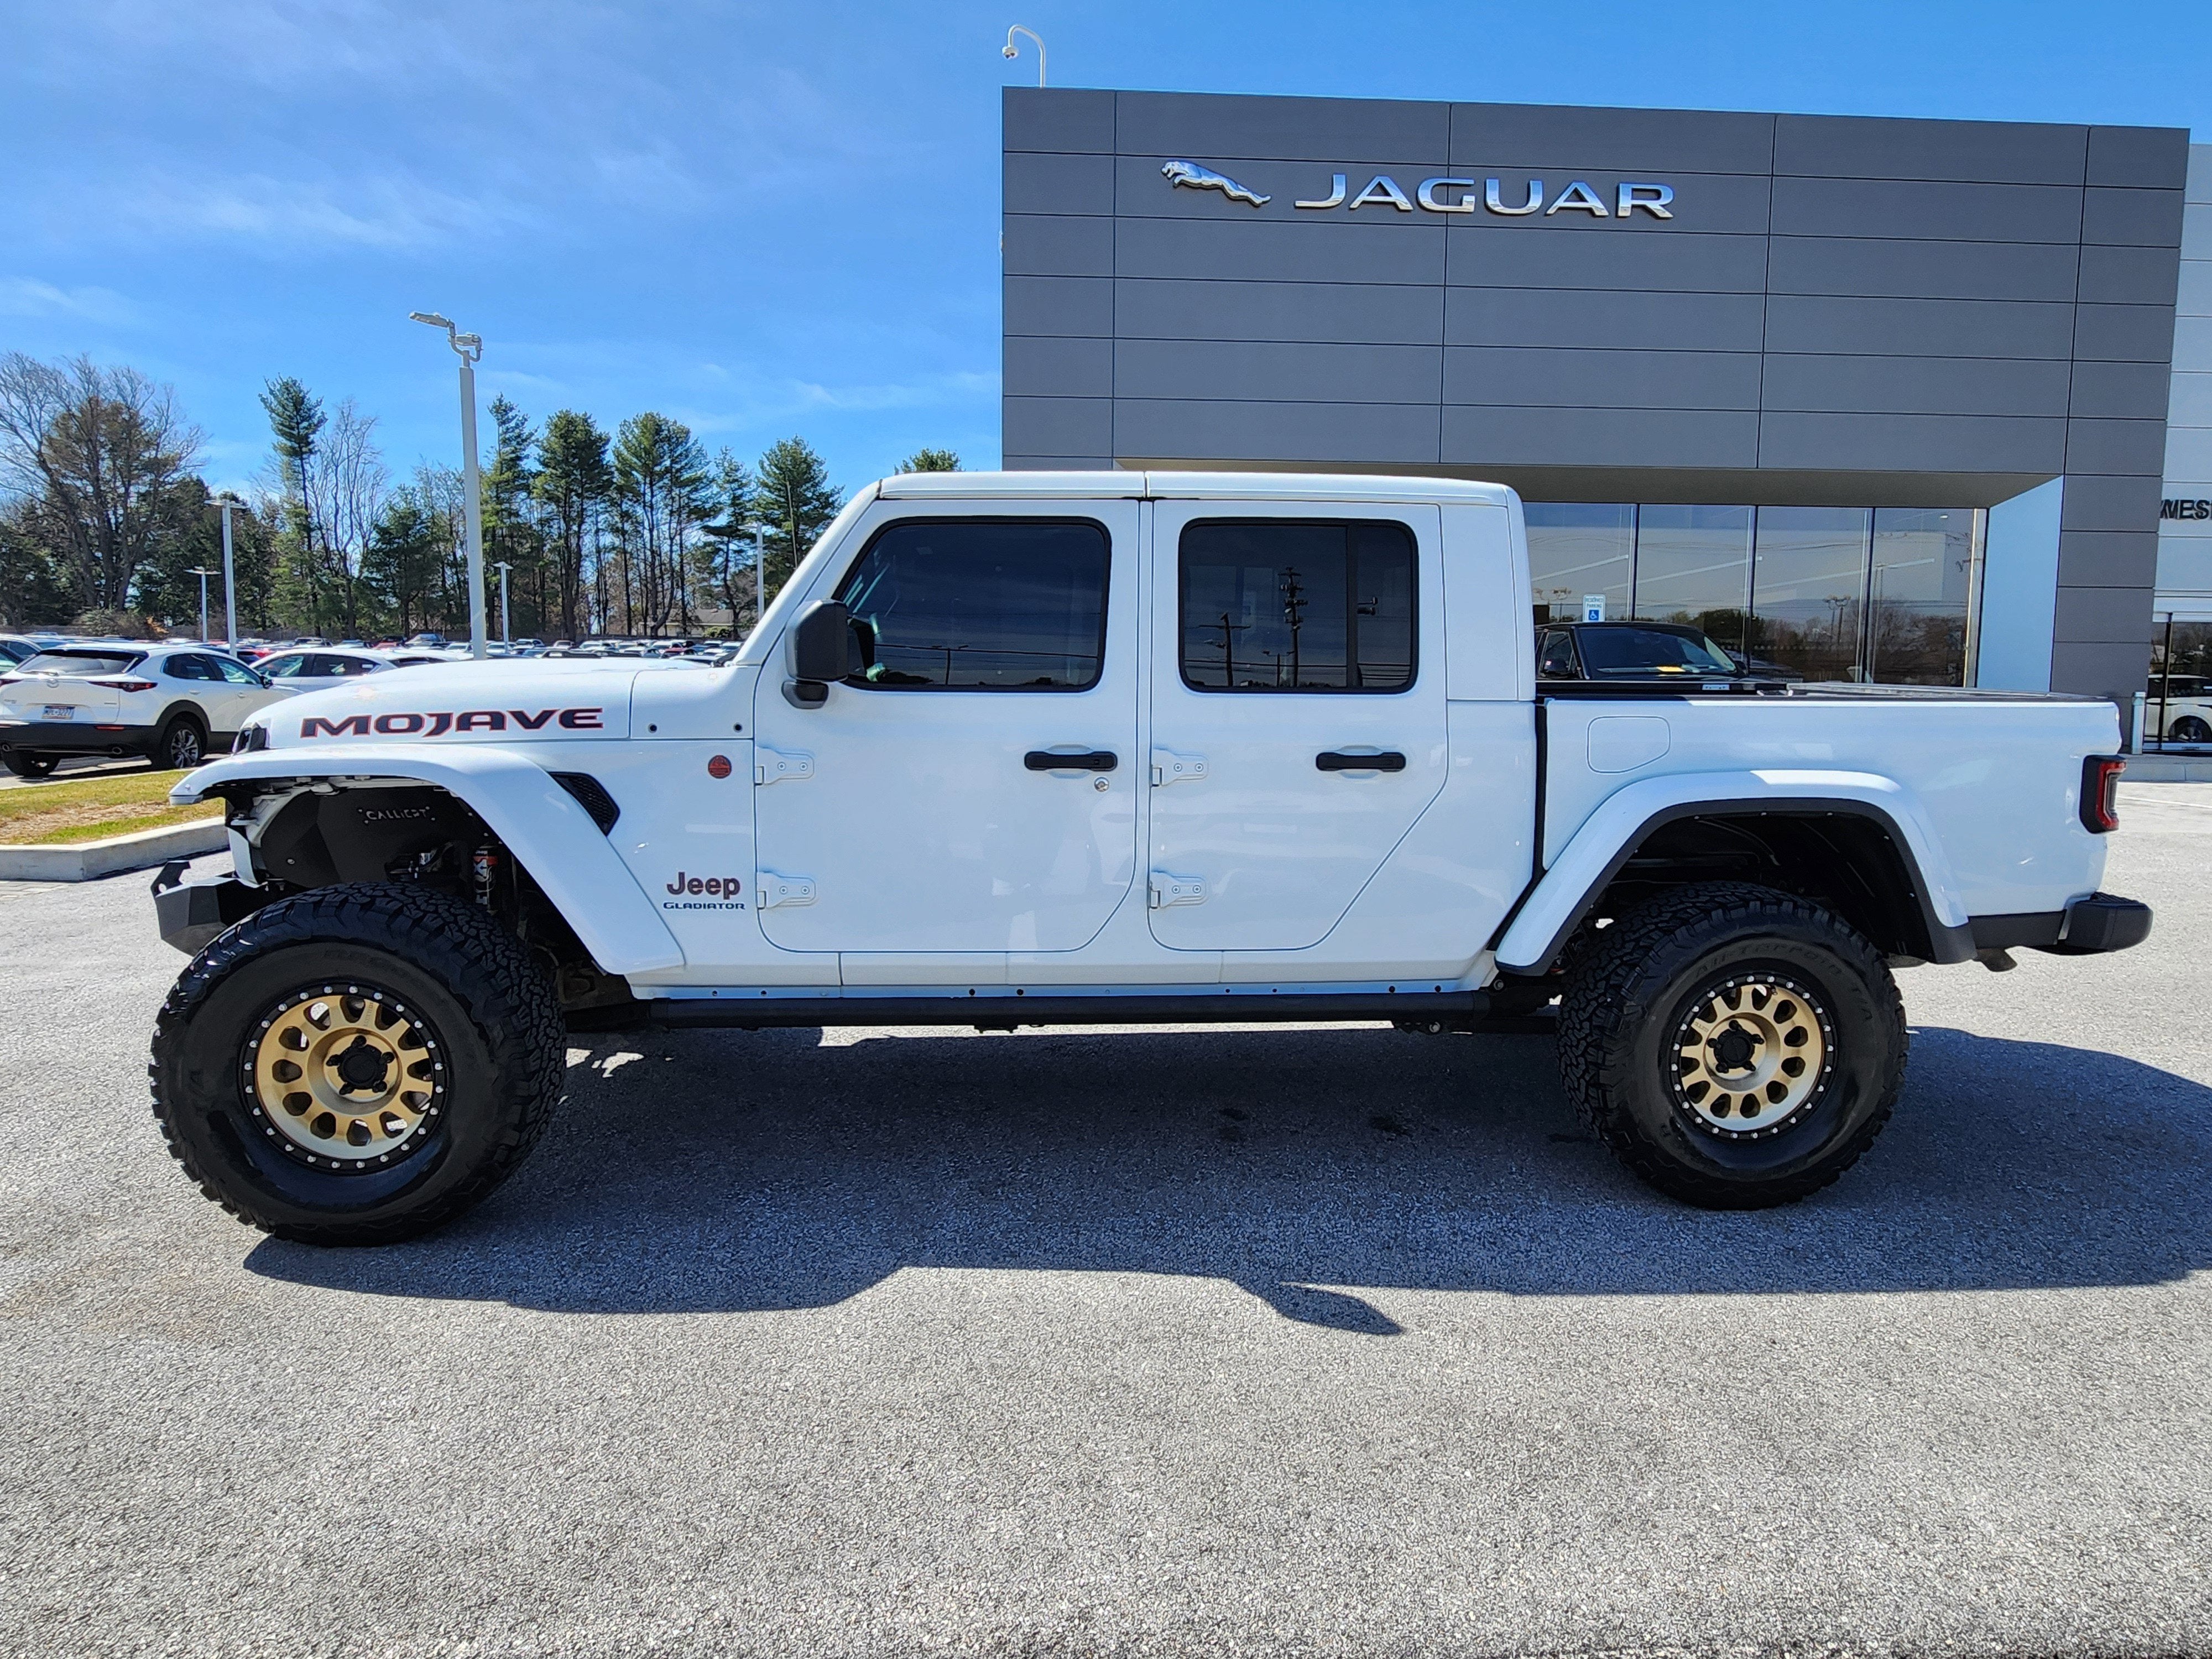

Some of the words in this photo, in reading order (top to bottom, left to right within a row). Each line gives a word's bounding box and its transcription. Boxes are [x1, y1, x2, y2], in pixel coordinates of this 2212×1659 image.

[1295, 174, 1674, 218] JAGUAR
[2160, 499, 2212, 519] WES
[300, 708, 603, 738] MOJAVE
[666, 872, 740, 900] Jeep
